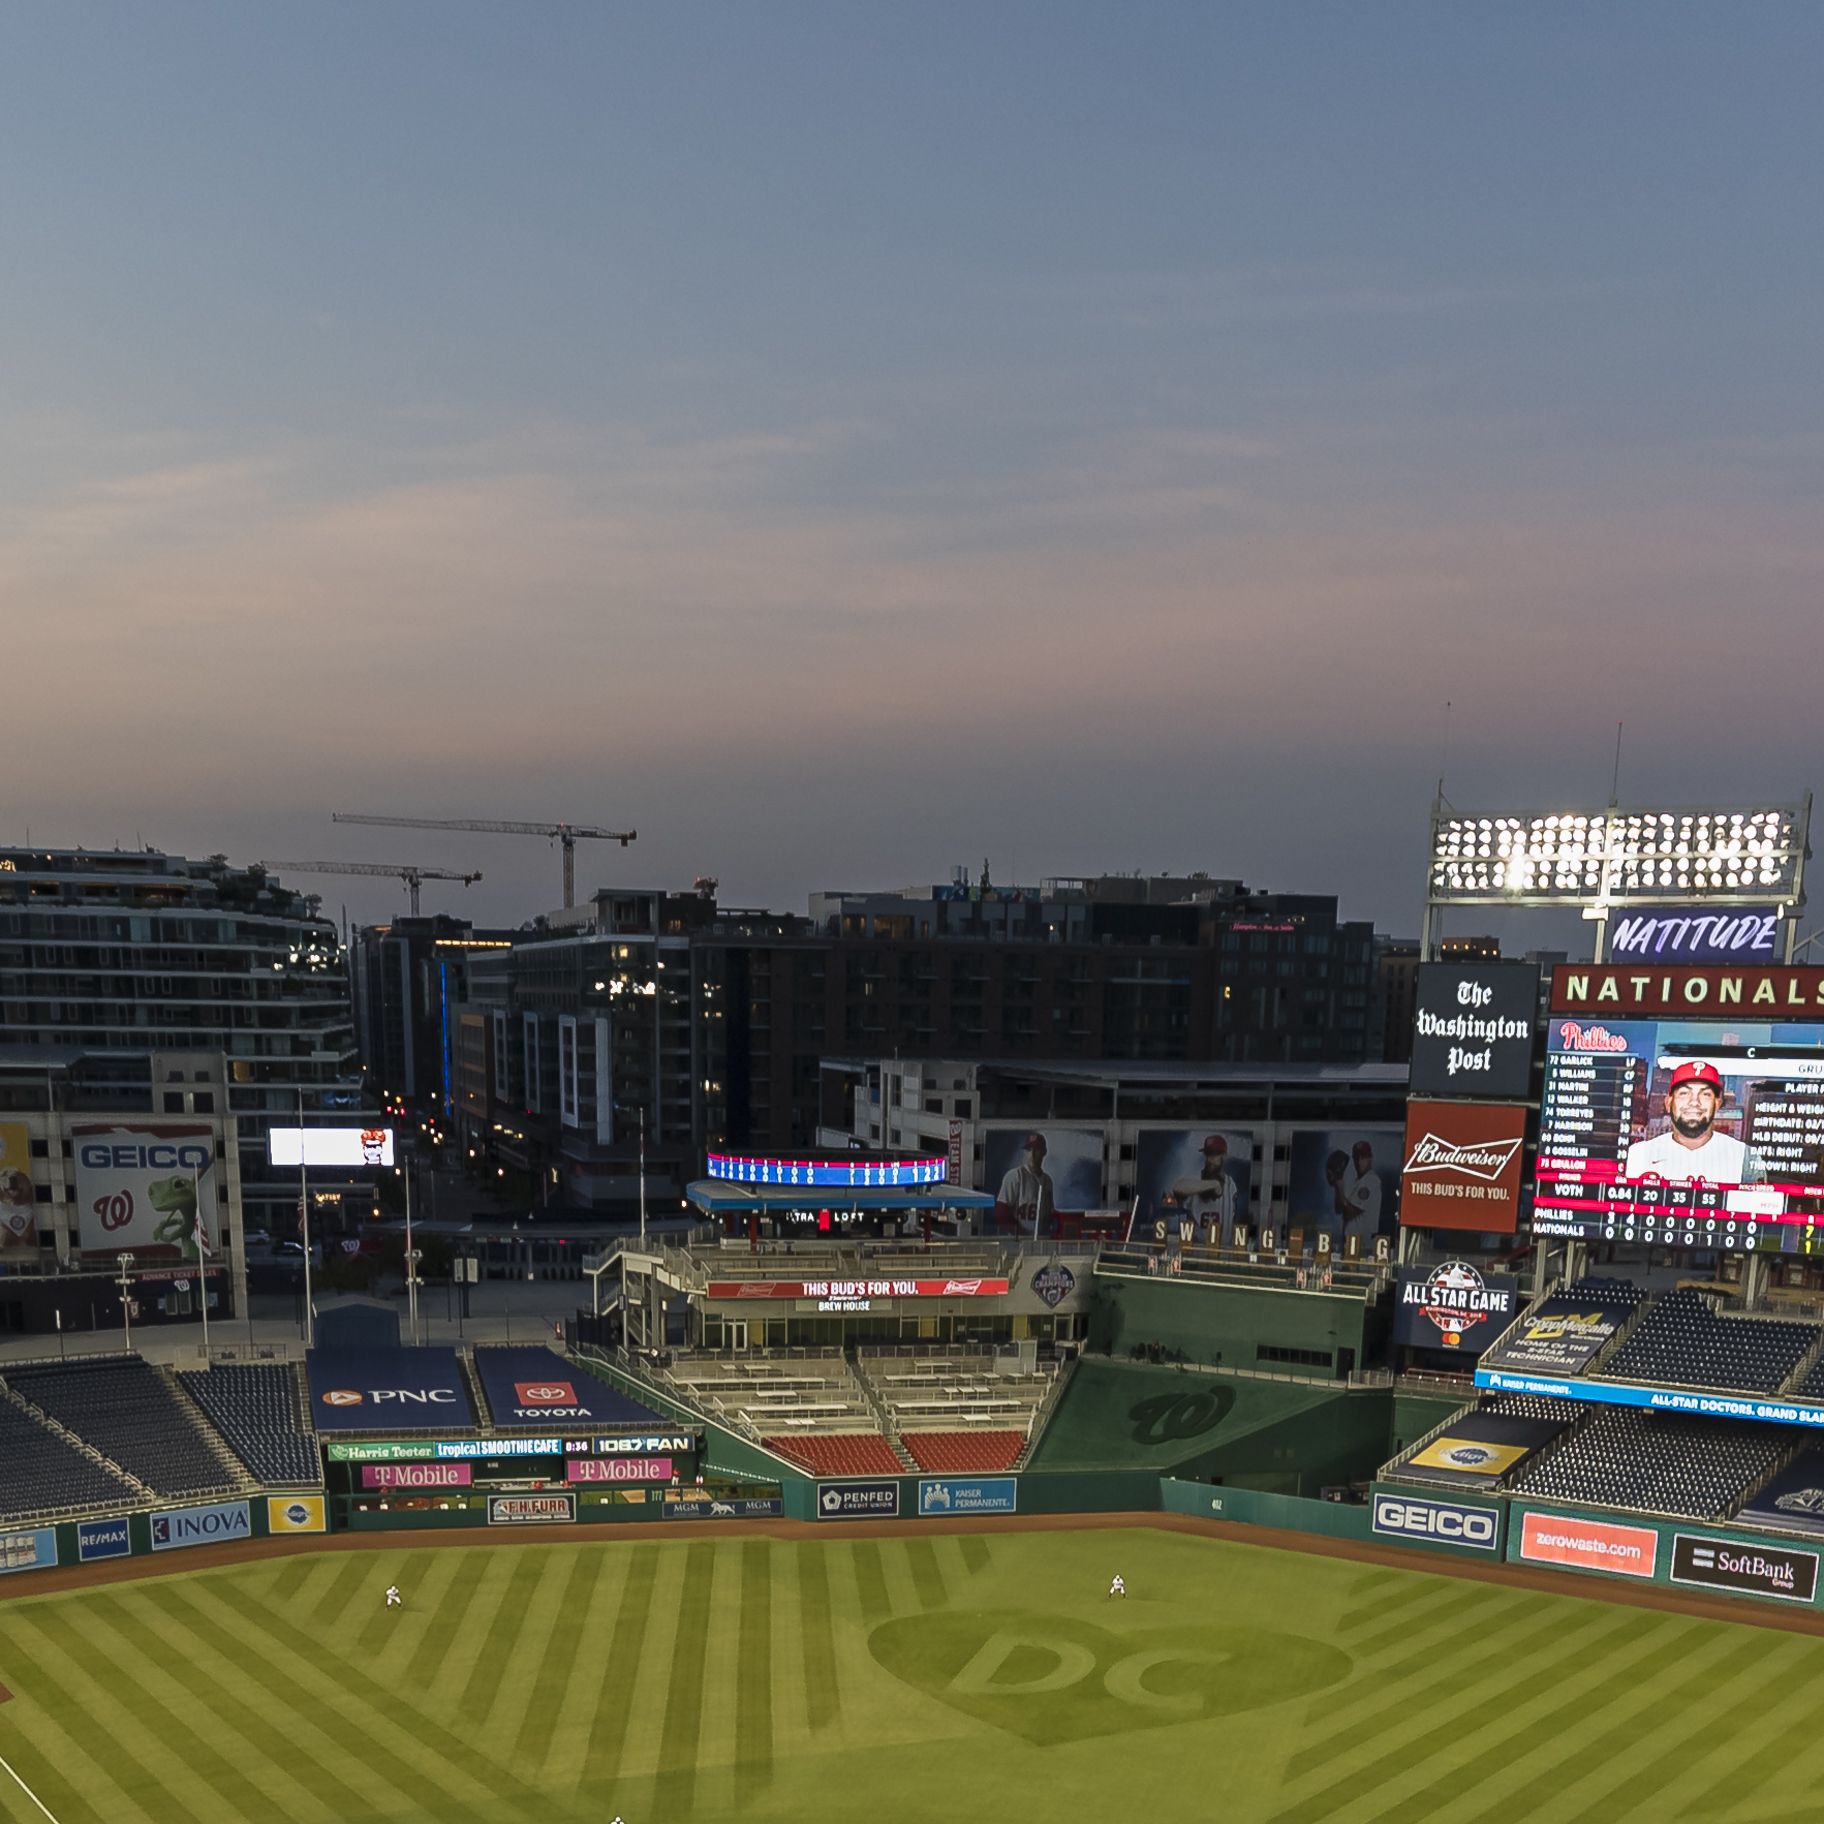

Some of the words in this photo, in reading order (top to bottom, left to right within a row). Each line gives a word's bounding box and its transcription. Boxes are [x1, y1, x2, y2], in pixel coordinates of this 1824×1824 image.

[1613, 915, 1777, 954] NATITUDE
[1457, 981, 1493, 1008] The
[1417, 1008, 1528, 1044] Washington
[1560, 1021, 1627, 1051] Phillies
[1447, 1047, 1491, 1075] Post
[1785, 1083, 1818, 1094] PLAYER
[81, 1145, 210, 1169] GEICO
[1414, 1141, 1509, 1167] Budweiser
[1411, 1182, 1432, 1195] THIS
[1434, 1184, 1463, 1198] BUD'S
[1465, 1186, 1484, 1199] FOR
[1487, 1187, 1510, 1200] YOU.
[1555, 1184, 1584, 1197] VOTH
[1643, 1190, 1658, 1202] 20
[1673, 1191, 1686, 1203] 35
[1702, 1193, 1716, 1205] 55
[834, 1212, 864, 1222] LOFT
[1534, 1207, 1574, 1221] PHILLIES
[1533, 1222, 1585, 1237] NATIONALS
[1155, 1220, 1274, 1248] SWING
[1318, 1234, 1389, 1258] BIG
[142, 1271, 172, 1280] ADVANCE
[803, 1281, 828, 1295] THIS
[831, 1281, 866, 1295] BUD'S
[868, 1281, 891, 1295] FOR
[893, 1281, 918, 1295] YOU.
[1403, 1284, 1428, 1304] ALL
[1431, 1286, 1466, 1308] STAR
[1470, 1289, 1509, 1312] GAME
[819, 1301, 842, 1311] BREW
[843, 1301, 870, 1311] HOUSE
[1515, 1339, 1549, 1347] HOME
[1569, 1344, 1590, 1352] THE
[1506, 1351, 1576, 1365] TECHNICIAN
[368, 1389, 457, 1404] PNC
[514, 1408, 592, 1417] TOYOTA
[1651, 1394, 1699, 1410] ALL-STAR
[1700, 1400, 1755, 1416] DOCTORS.
[1757, 1406, 1797, 1420] GRAND
[437, 1442, 479, 1458] tropical
[480, 1440, 532, 1456] SMOOTHIE
[533, 1439, 558, 1455] CAFE
[646, 1438, 689, 1451] FAN
[349, 1446, 390, 1460] Harris
[391, 1446, 432, 1459] Teeter
[396, 1466, 459, 1486] Mobile
[598, 1459, 660, 1480] Mobile
[844, 1491, 893, 1503] PENFED
[955, 1490, 982, 1499] KAISER
[531, 1499, 566, 1513] FURR
[673, 1503, 700, 1514] MGM
[745, 1501, 772, 1512] MGM
[177, 1509, 249, 1538] INOVA
[1379, 1502, 1493, 1541] GEICO
[81, 1530, 127, 1547] RE/MAX
[1536, 1531, 1641, 1560] zerowaste.com
[1717, 1551, 1795, 1581] SoftBank
[1772, 1579, 1794, 1590] Group
[948, 1633, 1230, 1714] DC
